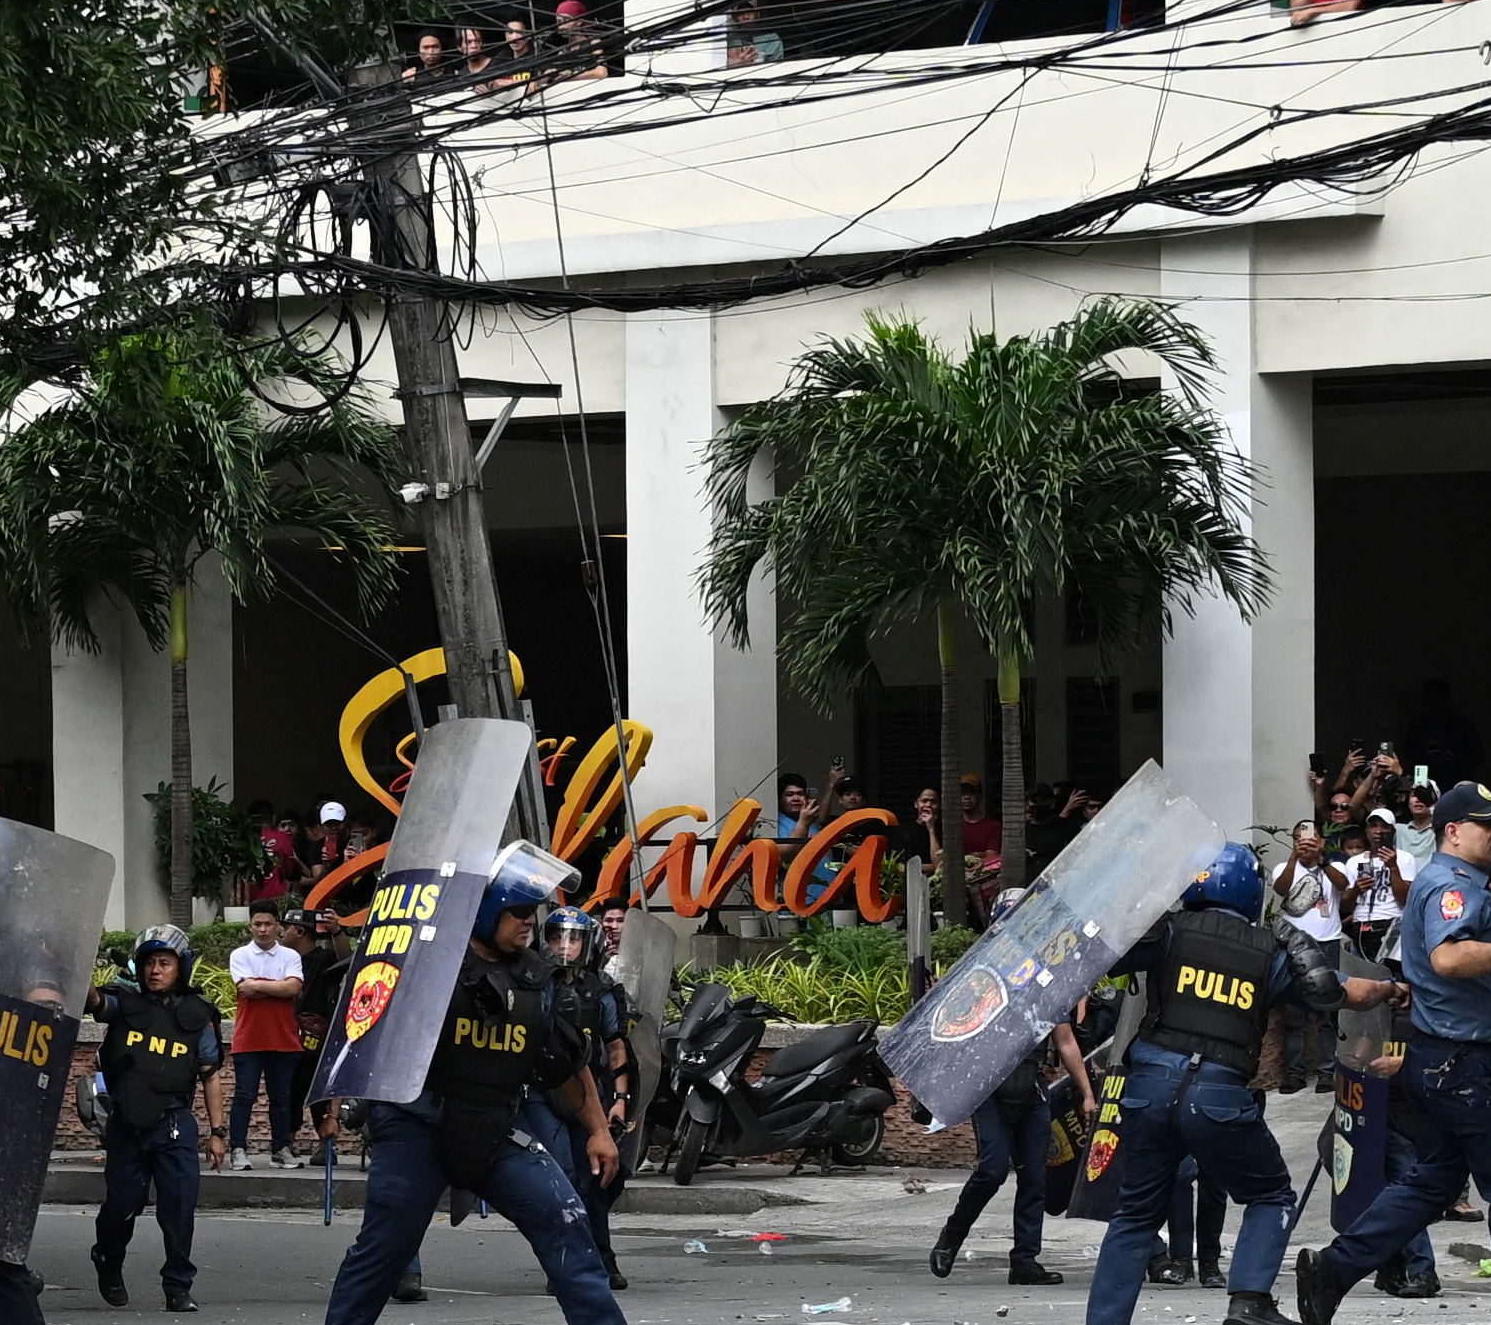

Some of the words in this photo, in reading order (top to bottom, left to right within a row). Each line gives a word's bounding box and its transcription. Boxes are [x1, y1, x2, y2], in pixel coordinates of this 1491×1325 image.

[367, 883, 441, 926] PULIS
[365, 925, 414, 957] MPD
[1176, 965, 1255, 1010] PULIS
[126, 1030, 188, 1058] PNP
[454, 1017, 527, 1053] PULIS
